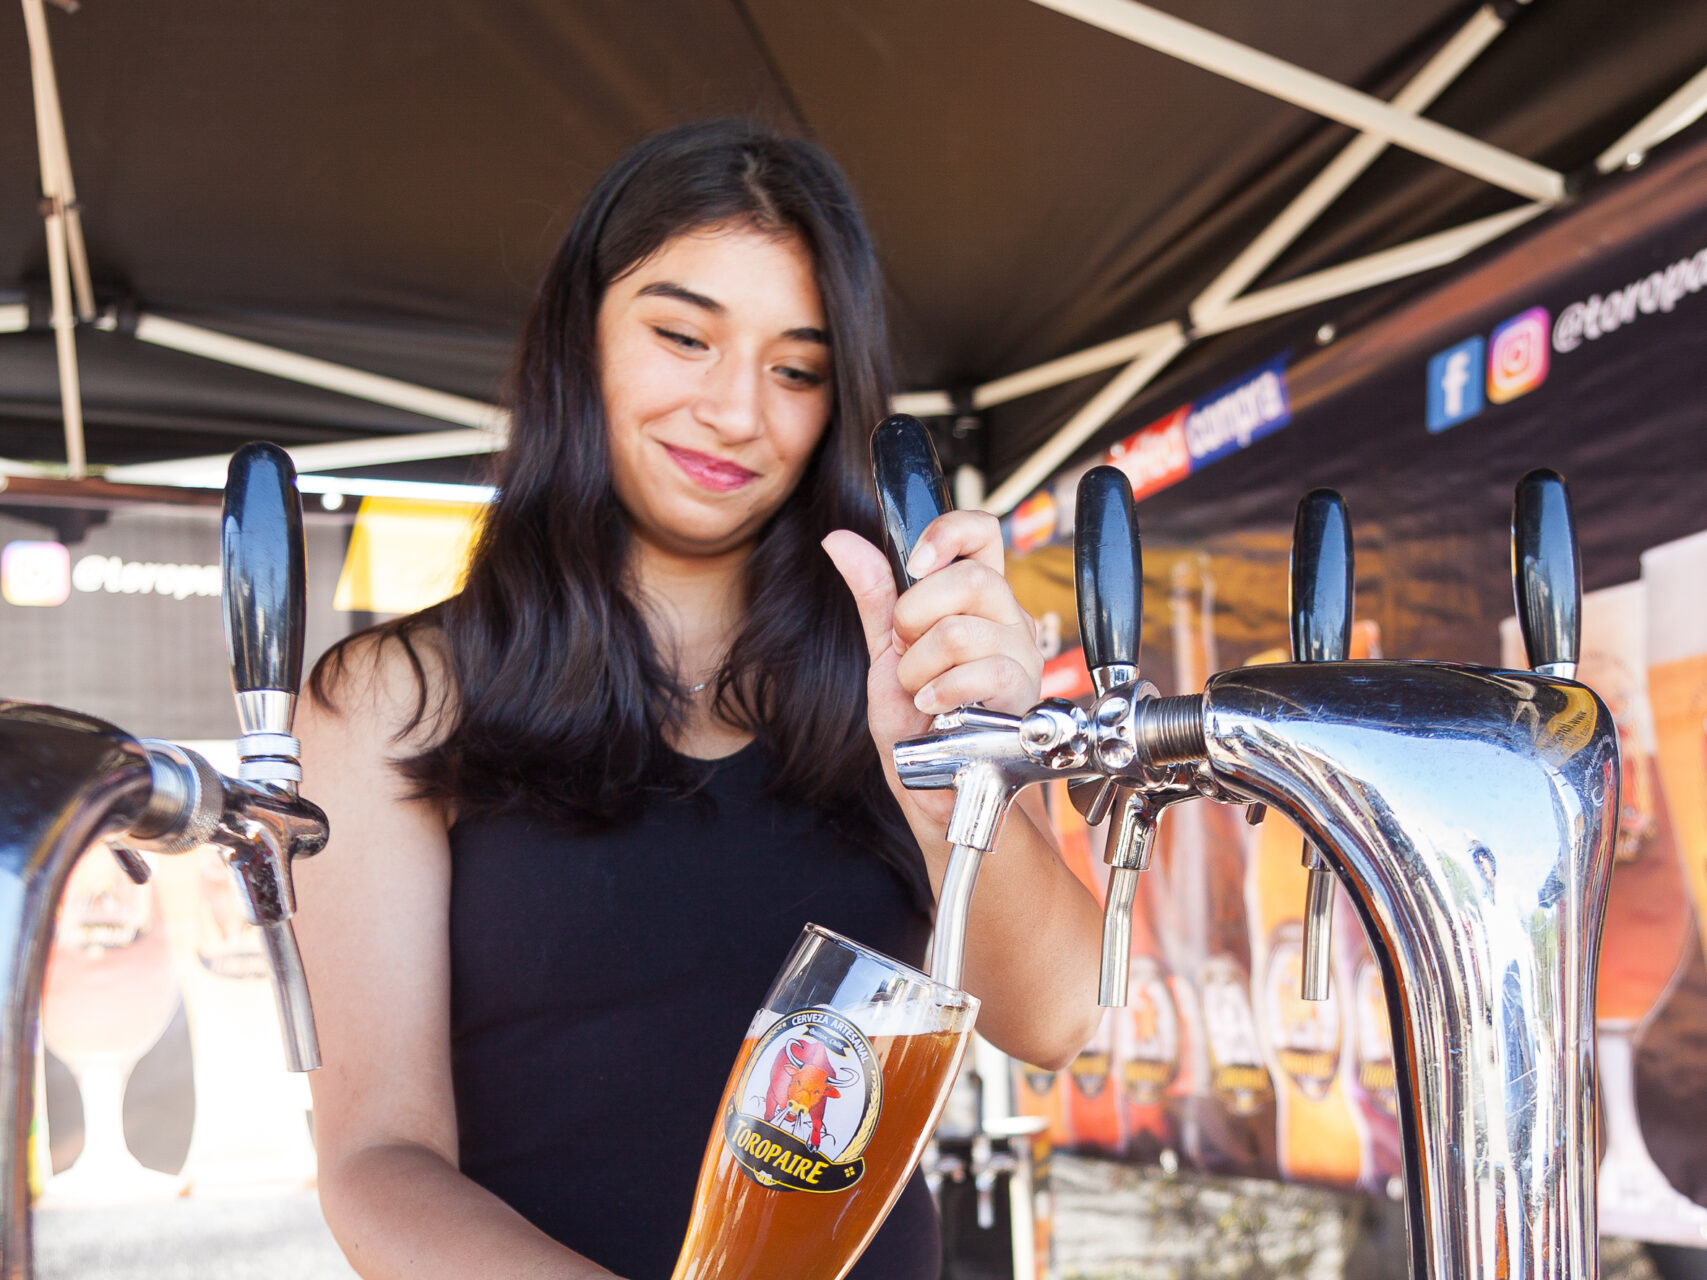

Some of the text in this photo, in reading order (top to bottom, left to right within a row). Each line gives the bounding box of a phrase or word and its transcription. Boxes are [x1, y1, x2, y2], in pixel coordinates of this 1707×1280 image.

[791, 1013, 870, 1063] CERVEZA ARTESANAL
[731, 1119, 829, 1185] TOROPAIRE
